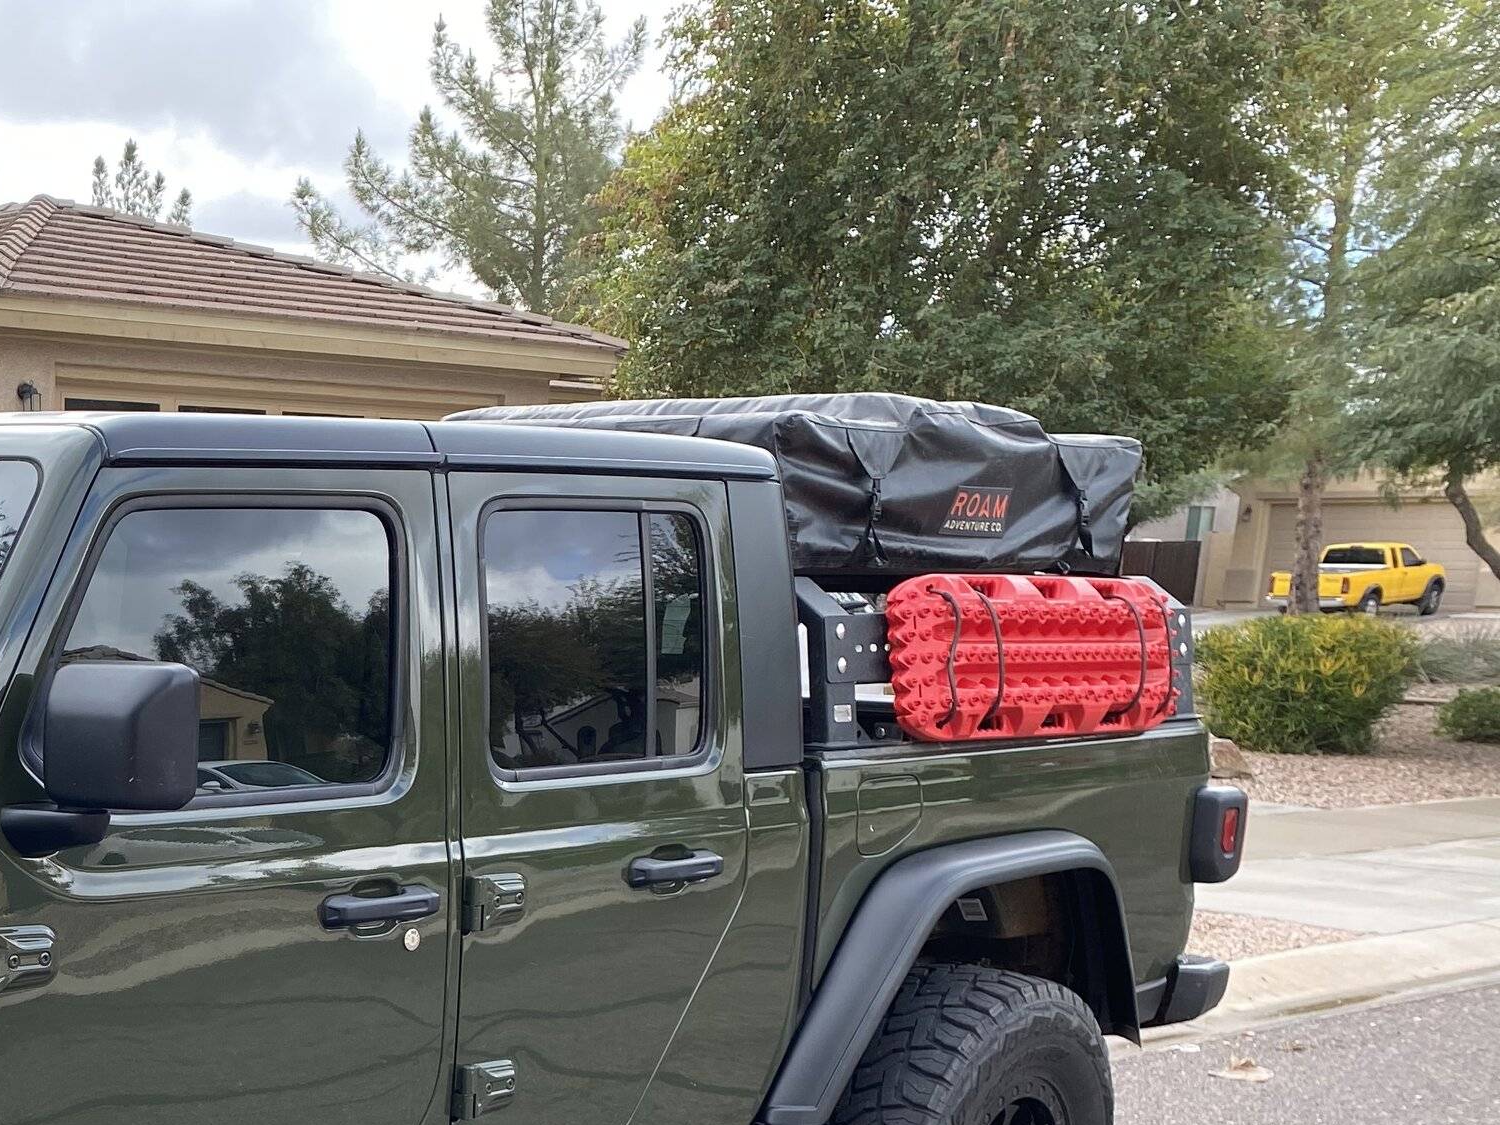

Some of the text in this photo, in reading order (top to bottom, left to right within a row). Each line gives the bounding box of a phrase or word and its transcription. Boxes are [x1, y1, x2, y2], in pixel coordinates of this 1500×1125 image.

[950, 491, 1009, 518] ROAM
[943, 520, 1003, 532] ADVENTURE CO.
